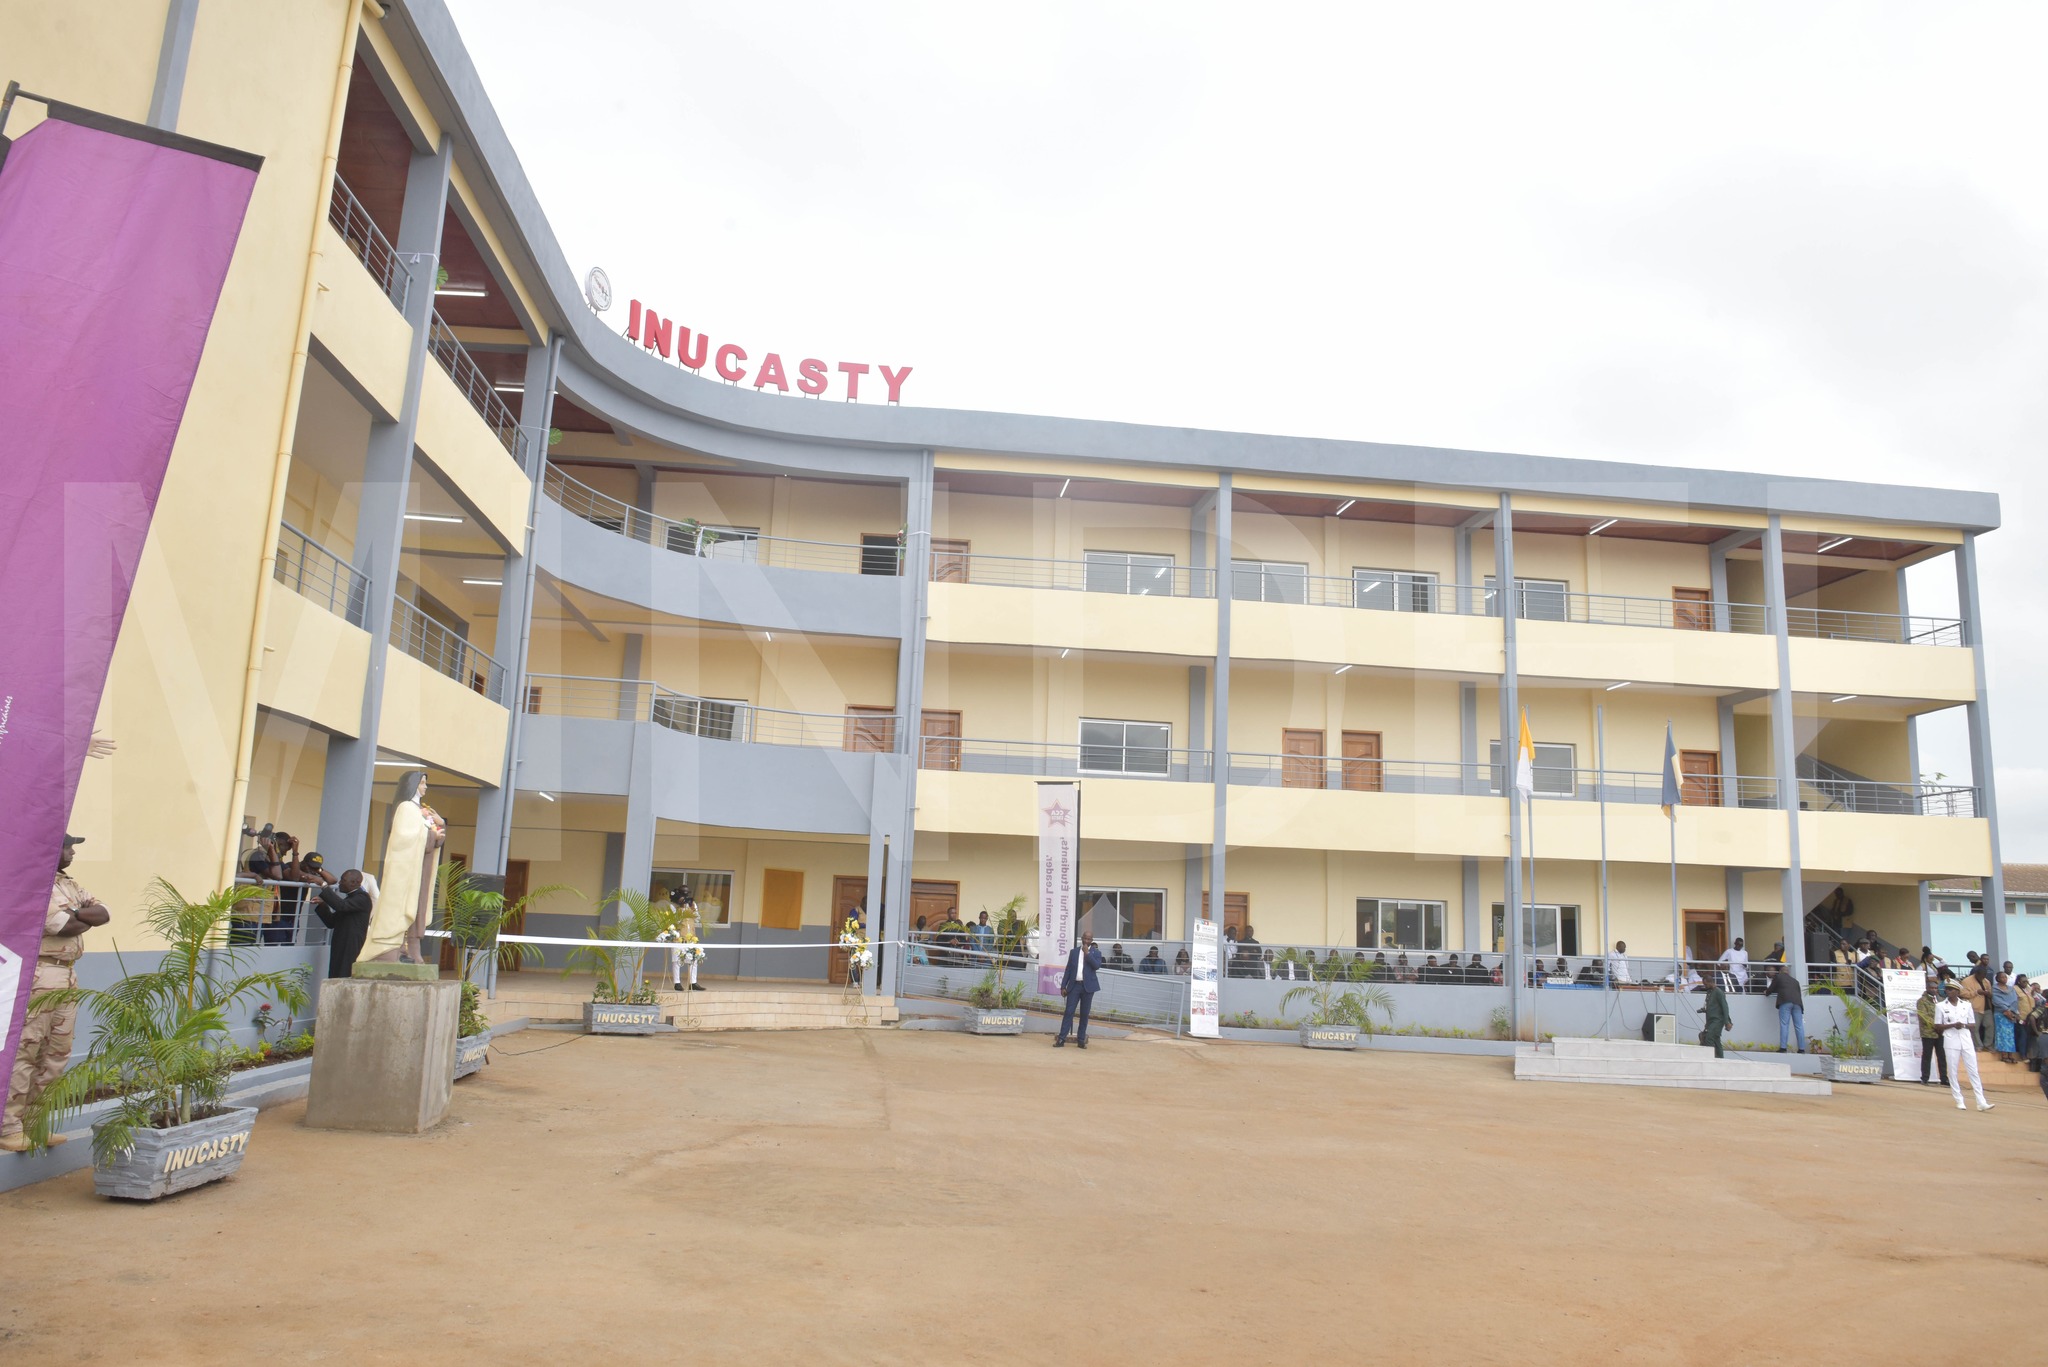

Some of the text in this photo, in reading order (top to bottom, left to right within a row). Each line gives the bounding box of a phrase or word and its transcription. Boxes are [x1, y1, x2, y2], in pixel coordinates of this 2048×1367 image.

[628, 299, 913, 402] INUCASTY
[597, 1013, 655, 1024] INUCASTY
[982, 1016, 1023, 1025] INUCASTY
[1312, 1031, 1356, 1041] INUCASTY
[1839, 1064, 1880, 1074] INUCASTY
[164, 1131, 249, 1173] INUCASTY
